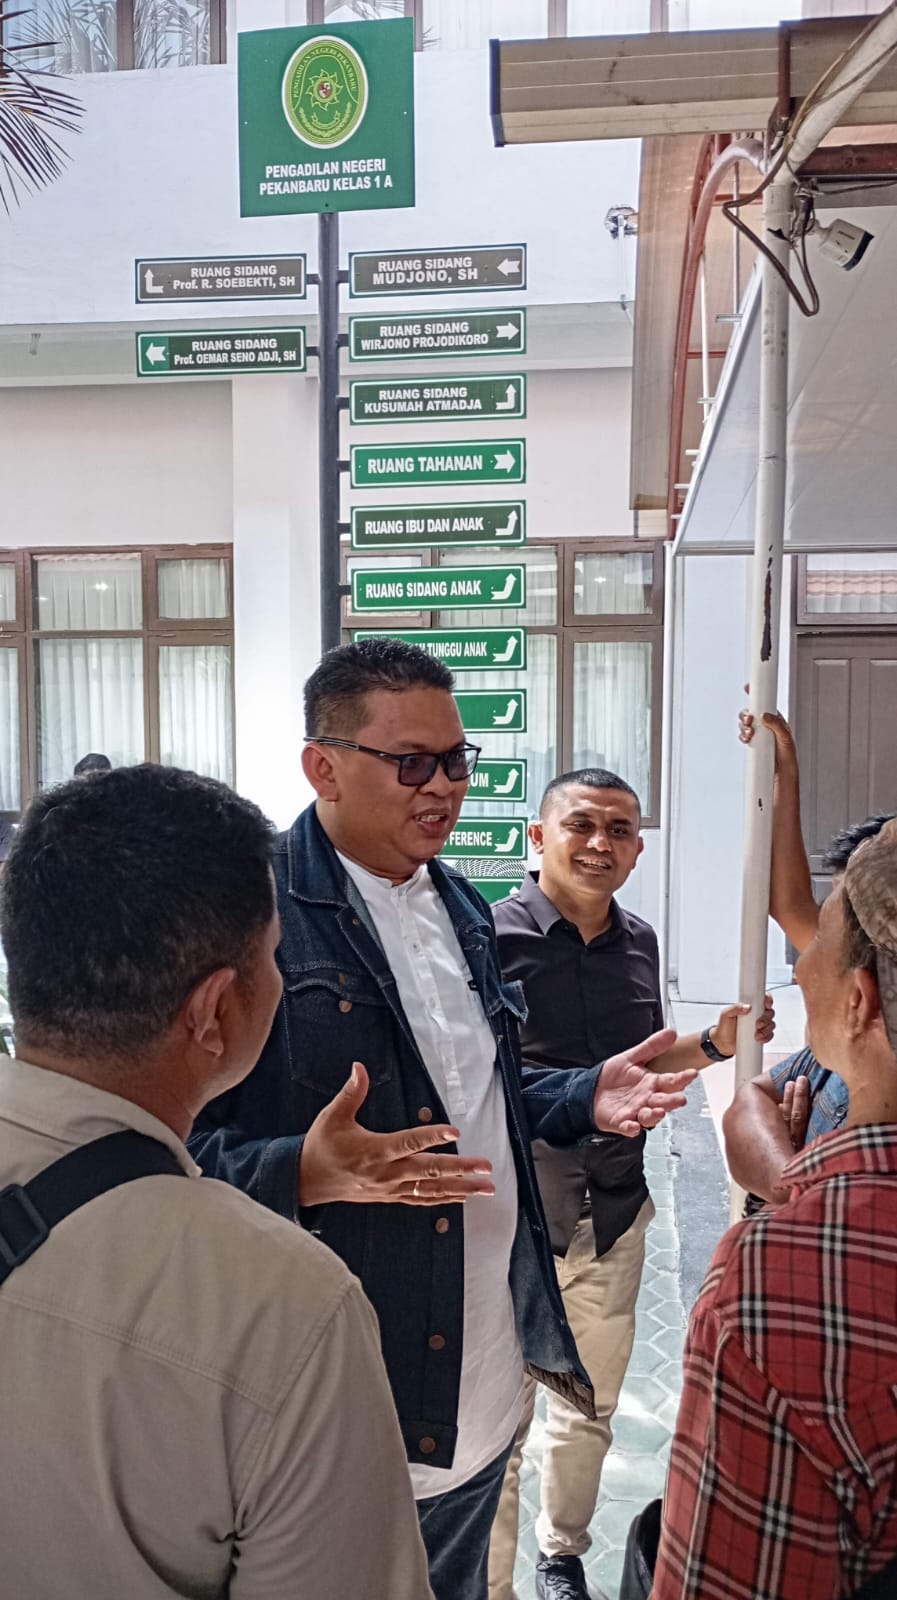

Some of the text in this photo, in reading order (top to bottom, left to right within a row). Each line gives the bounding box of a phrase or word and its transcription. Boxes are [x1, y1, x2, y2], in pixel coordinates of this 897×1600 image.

[265, 158, 386, 178] PENGADILAN NEGERI
[259, 175, 393, 195] PEKANBARU KELAS 1 A
[190, 265, 278, 278] RUANG SIDANG
[378, 256, 473, 272] RUANG SIDANG
[172, 276, 296, 290] Prof. R. SOEBEKTI, SH
[372, 268, 478, 285] MUDJONO, SH
[379, 321, 469, 337] RUANG SIDANG
[191, 338, 278, 352] RUANG SIDANG
[361, 334, 489, 351] WIRJONO PROJODIKORO
[173, 350, 297, 365] Prof. OEMAR SENO ADJI, SH
[378, 386, 468, 401] RUANG SIDANG
[364, 398, 482, 414] KUSUMAH ATMADJA
[367, 454, 484, 474] RUANG TAHANAN
[364, 516, 485, 535] RUANG IBU DAN ANAK
[365, 579, 482, 599] RUANG SIDANG ANAK
[427, 642, 463, 657] TUNGGU
[463, 641, 488, 657] ANAK
[468, 772, 489, 788] UM
[444, 831, 493, 848] FERENCE
